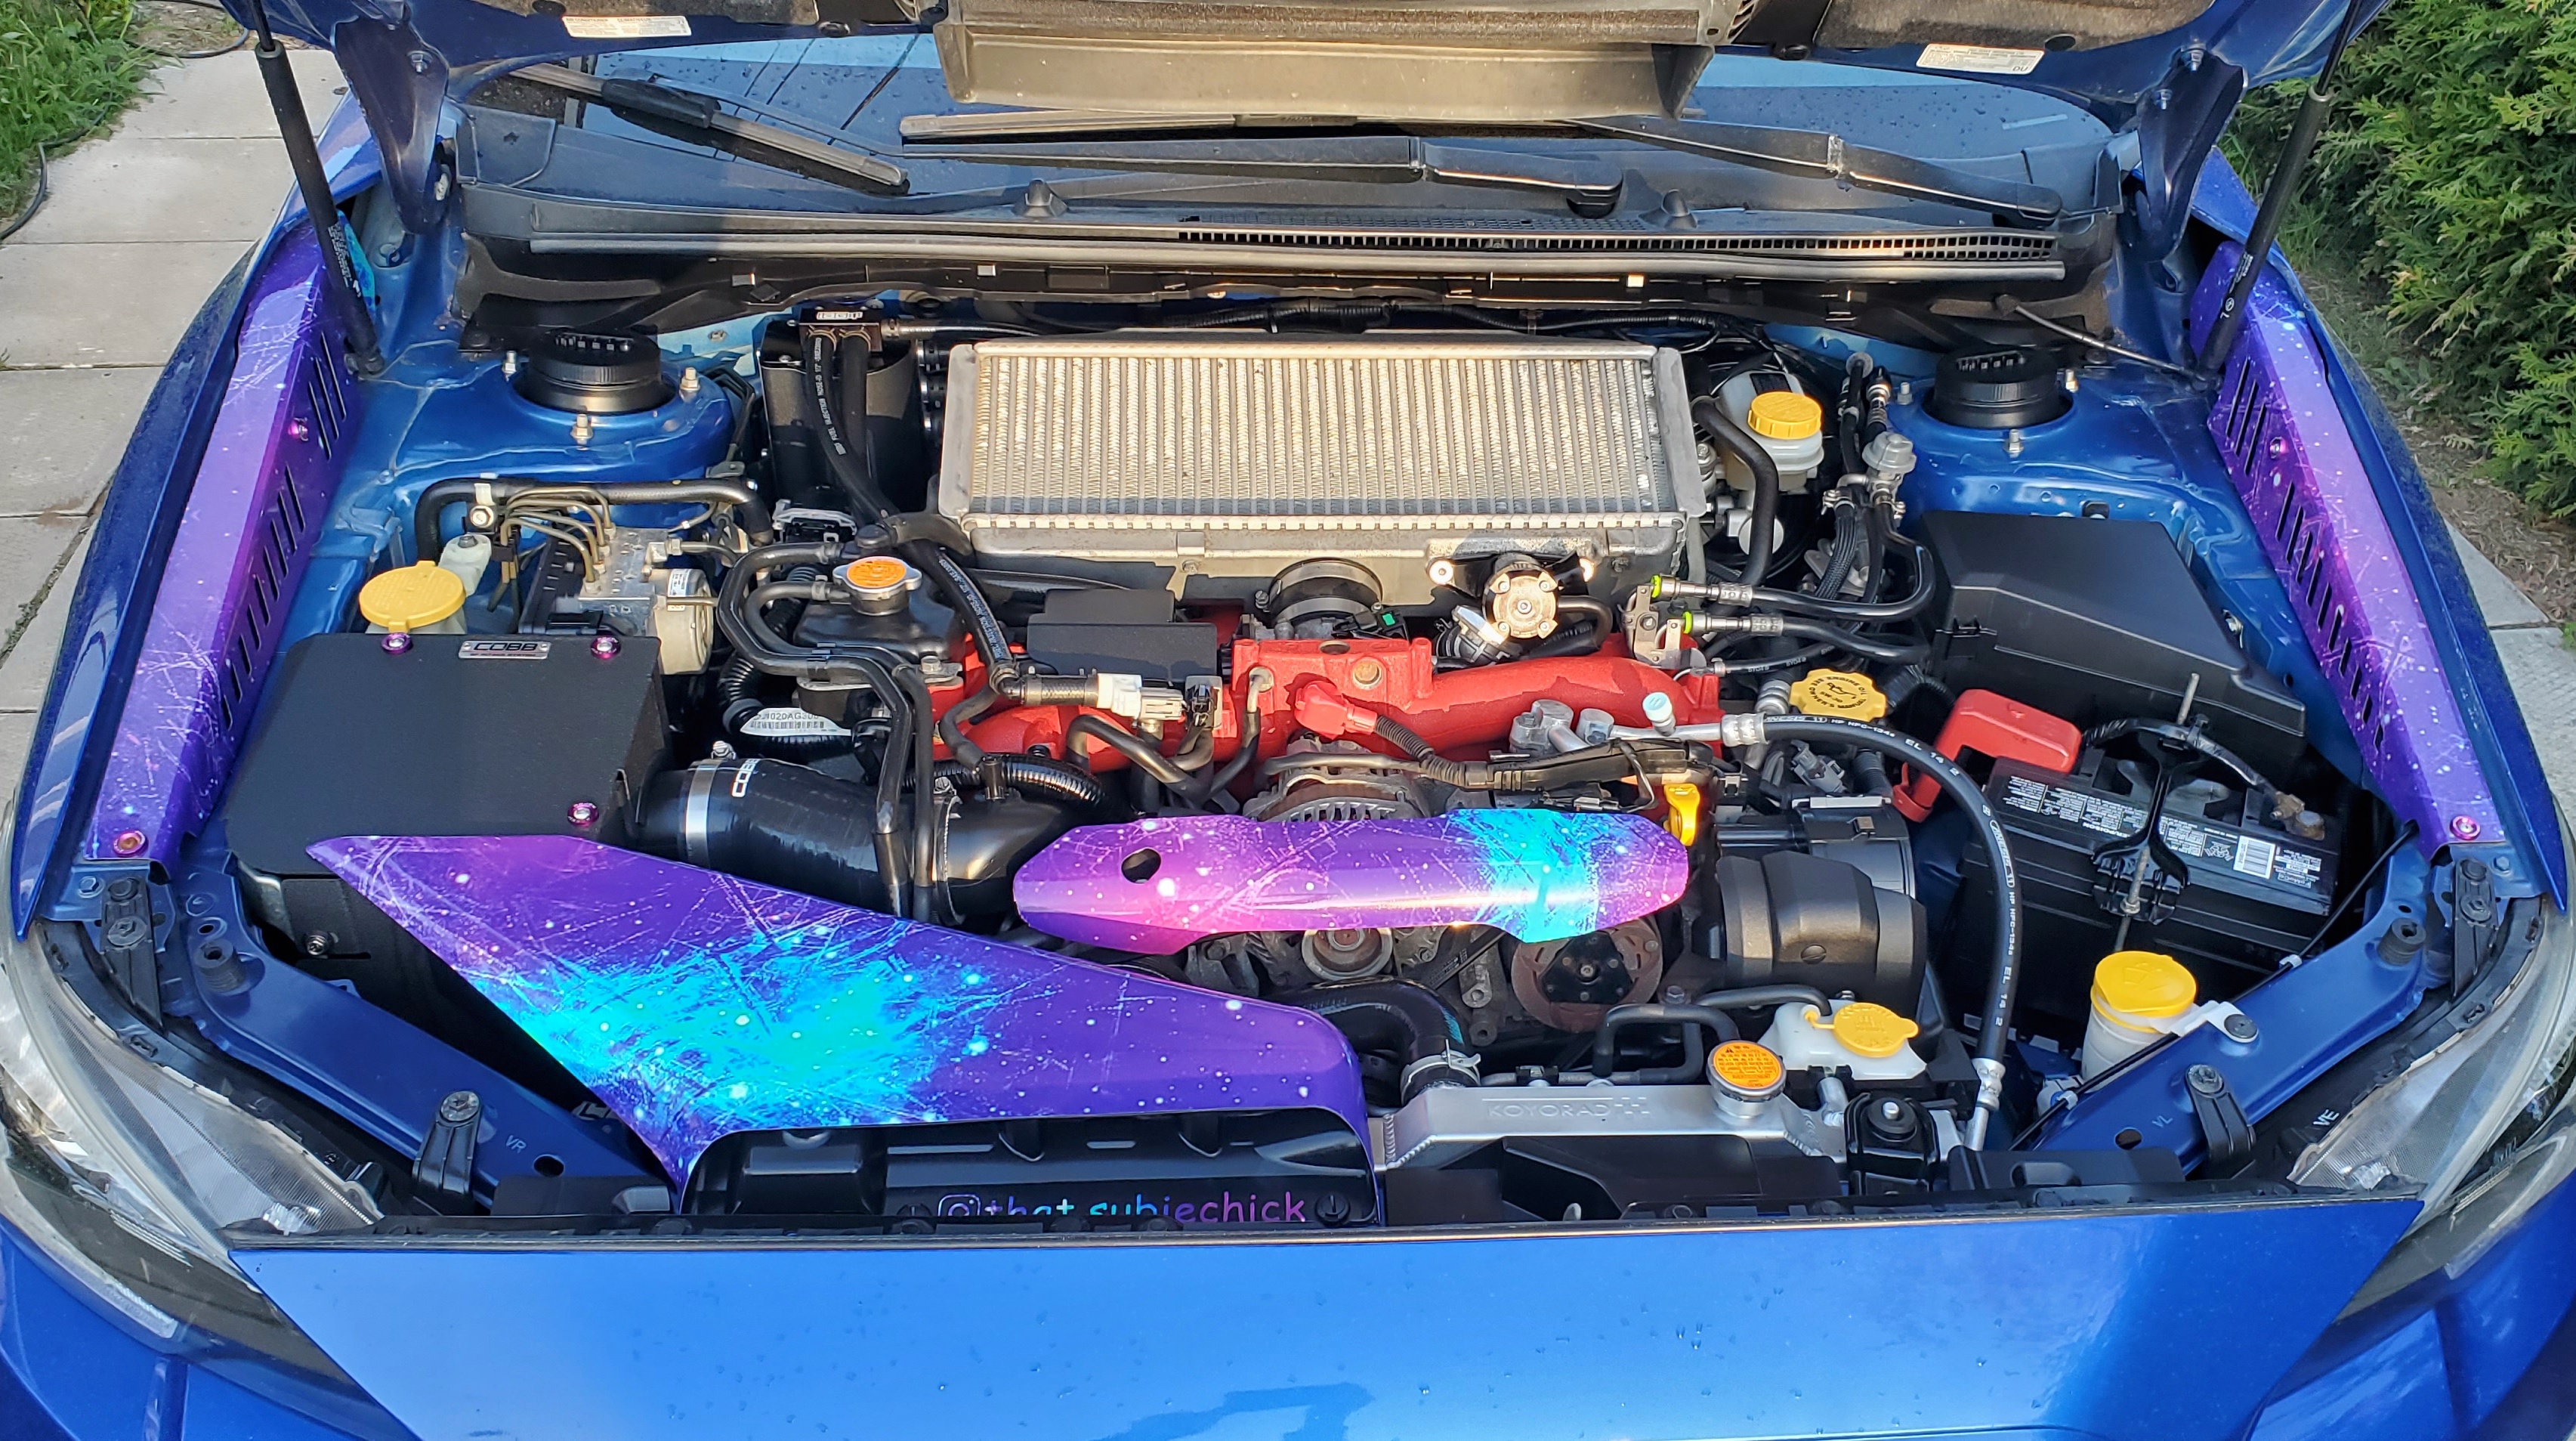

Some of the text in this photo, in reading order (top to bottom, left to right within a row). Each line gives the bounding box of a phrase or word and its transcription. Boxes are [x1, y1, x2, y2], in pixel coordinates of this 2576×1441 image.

[818, 398, 832, 425] INJECTION
[827, 426, 840, 441] FUEL
[474, 642, 538, 651] COBB
[1811, 676, 1867, 695] SEE ENGINE OIL
[1808, 687, 1867, 709] OWNER'S MANUAL
[1819, 691, 1843, 703] 5W-30
[1905, 738, 1923, 751] EL
[1929, 752, 1945, 764] 14
[1949, 767, 1960, 777] 2
[732, 758, 761, 798] COBB
[2009, 891, 2015, 904] HP
[2002, 966, 2012, 985] EL
[1999, 994, 2008, 1009] 14
[1995, 1016, 2003, 1027] 2
[1488, 1103, 1611, 1118] KOYORAD
[2312, 1109, 2340, 1127] VE
[2151, 1114, 2174, 1129] VL
[505, 1134, 527, 1155] VR
